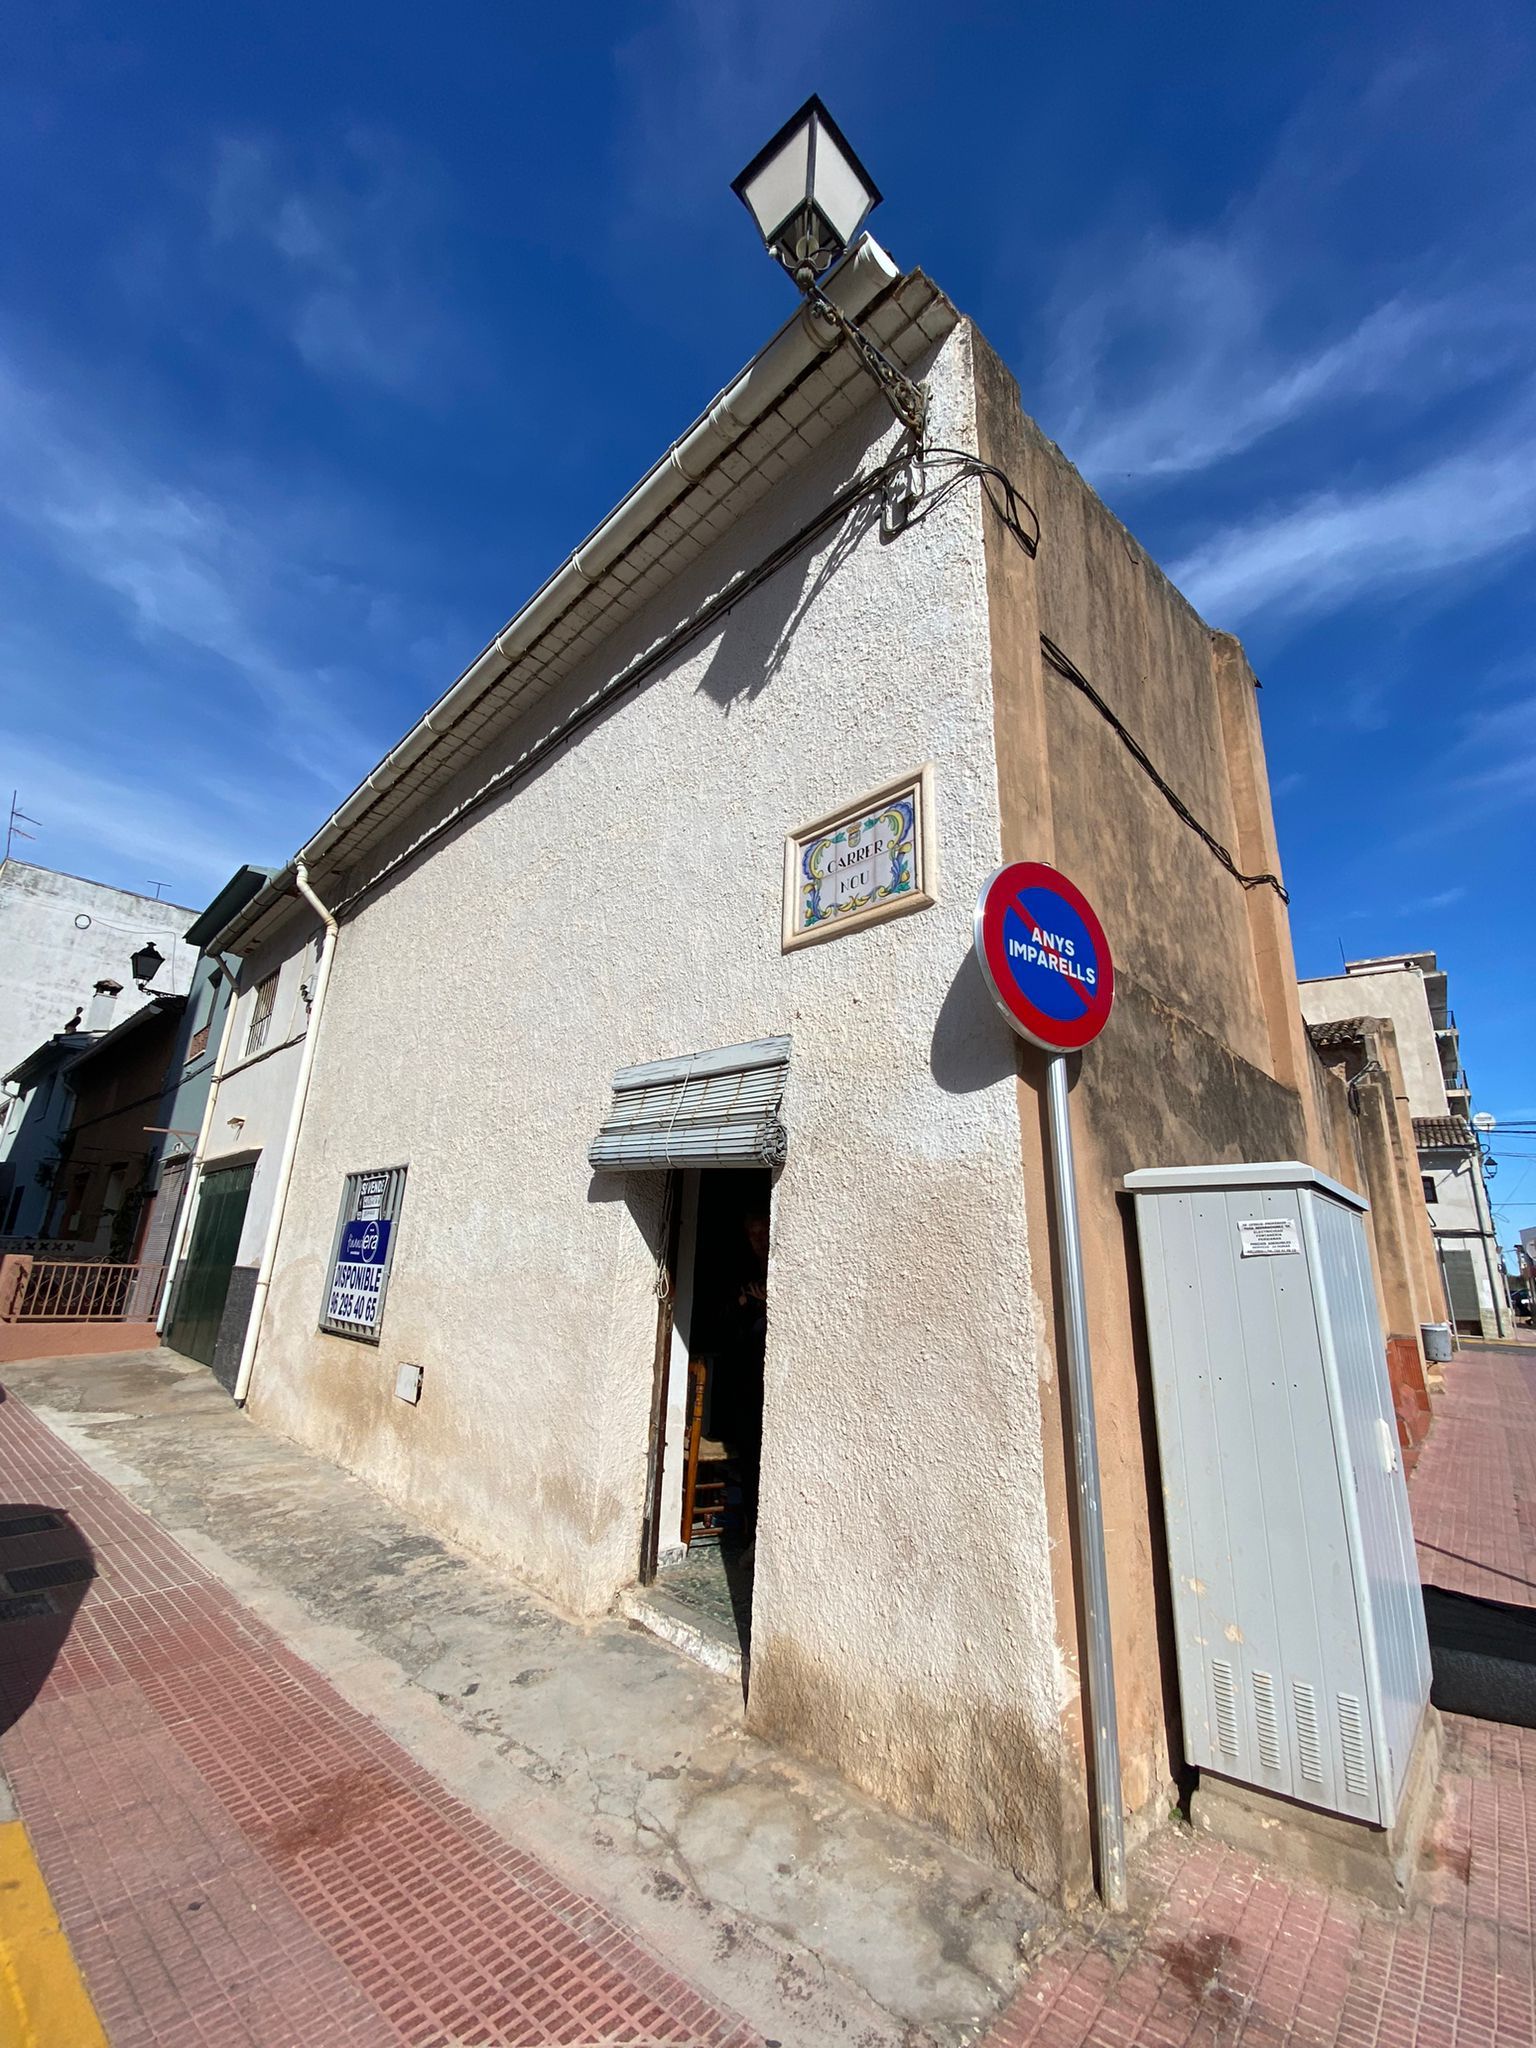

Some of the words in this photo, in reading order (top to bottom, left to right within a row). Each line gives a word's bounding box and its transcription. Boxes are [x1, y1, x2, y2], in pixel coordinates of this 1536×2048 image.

[826, 839, 884, 874] CARRER
[839, 870, 871, 894] NOU
[1031, 927, 1075, 956] ANYS
[1008, 938, 1096, 985] IMPARELLS
[334, 1264, 382, 1292] DISPONIBLE
[329, 1291, 339, 1315] 96
[337, 1292, 354, 1317] 295
[353, 1295, 365, 1320] 40
[365, 1297, 377, 1322] 65
